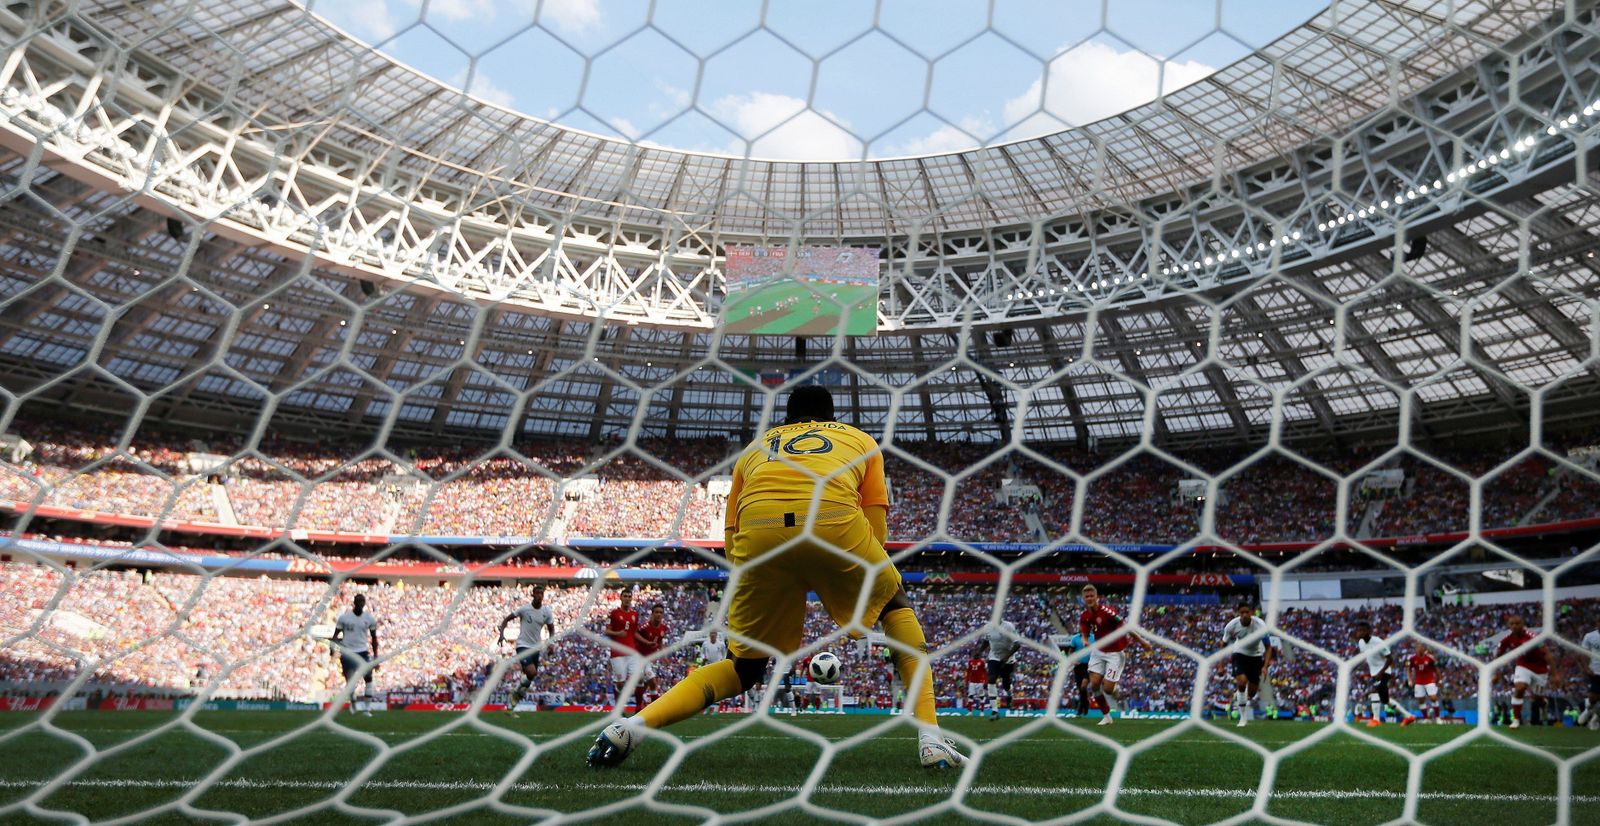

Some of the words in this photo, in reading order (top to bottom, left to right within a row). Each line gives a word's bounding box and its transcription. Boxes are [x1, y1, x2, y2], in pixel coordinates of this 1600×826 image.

[767, 429, 833, 462] 16
[527, 615, 532, 624] 3
[625, 620, 630, 630] 6
[1107, 668, 1117, 680] 21
